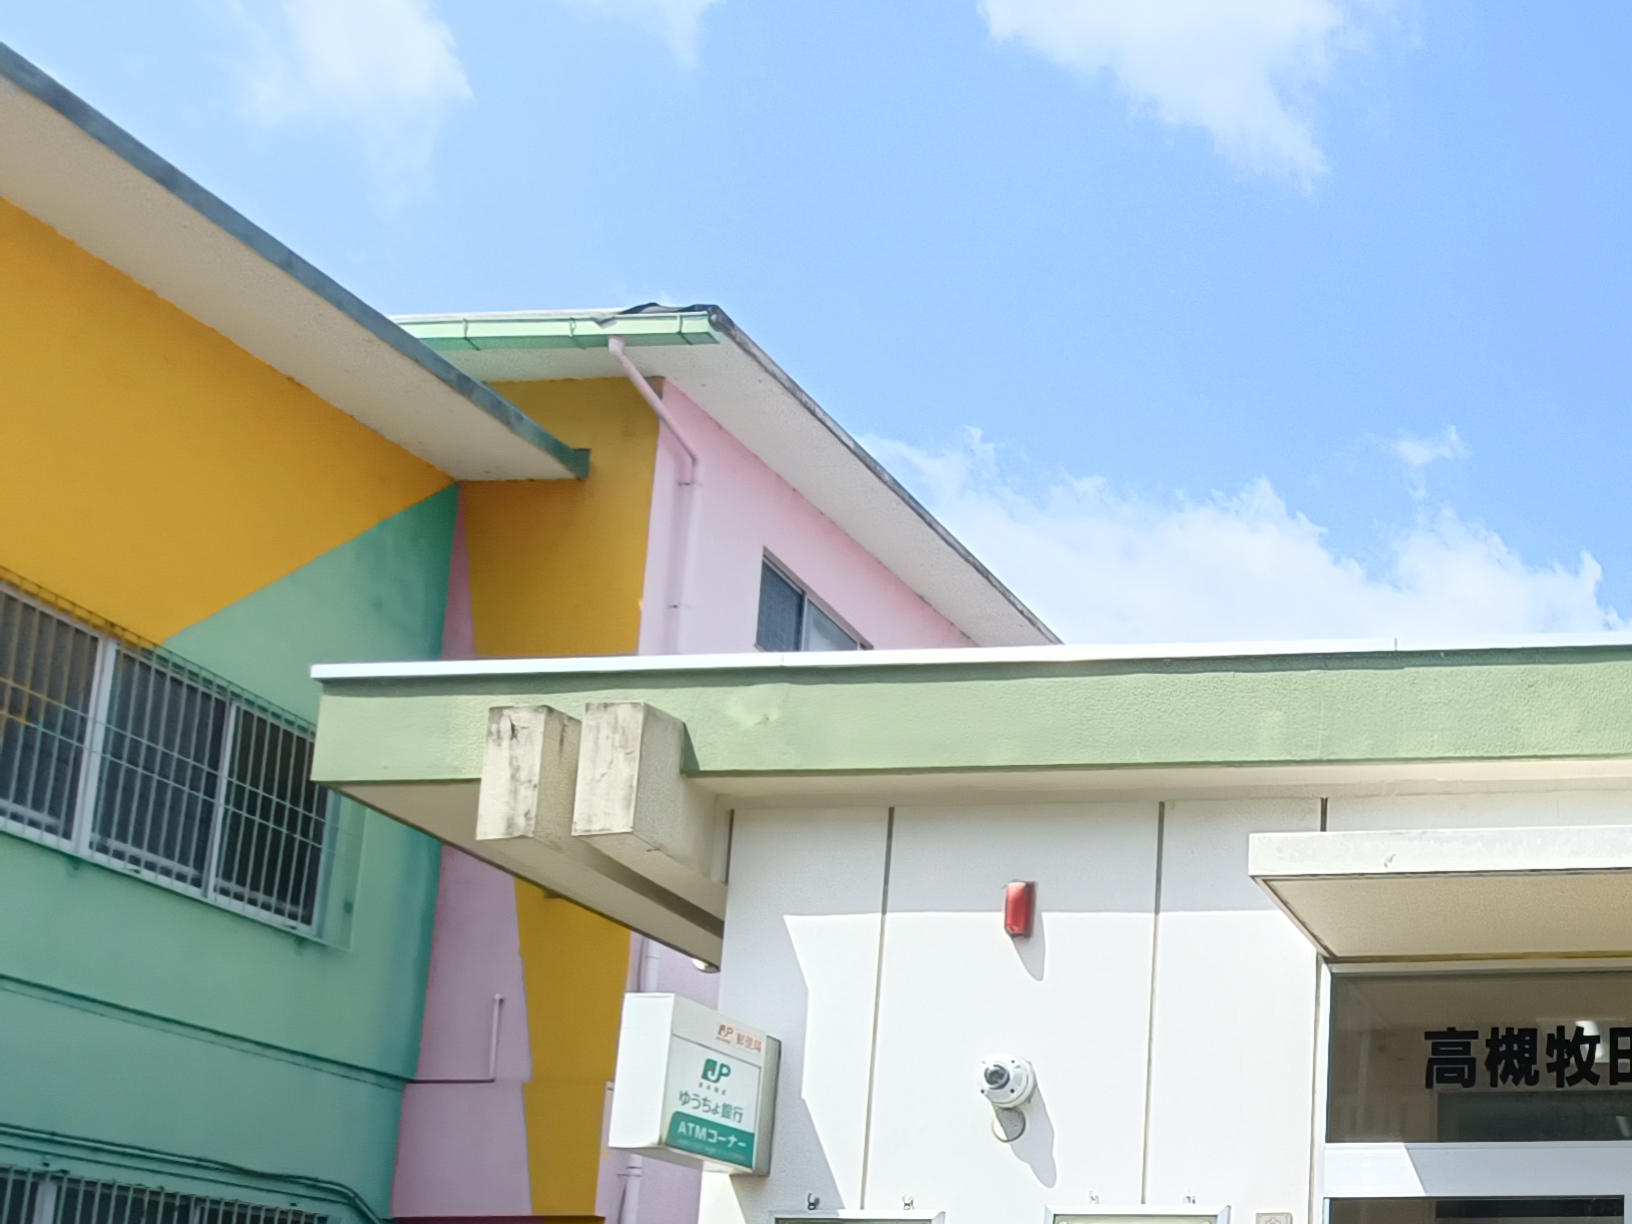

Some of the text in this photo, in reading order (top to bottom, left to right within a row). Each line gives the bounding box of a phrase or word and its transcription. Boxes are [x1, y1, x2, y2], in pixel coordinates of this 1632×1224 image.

[679, 1090, 744, 1123] ゆうちょ銀行
[677, 1121, 746, 1148] ATMコーナー
